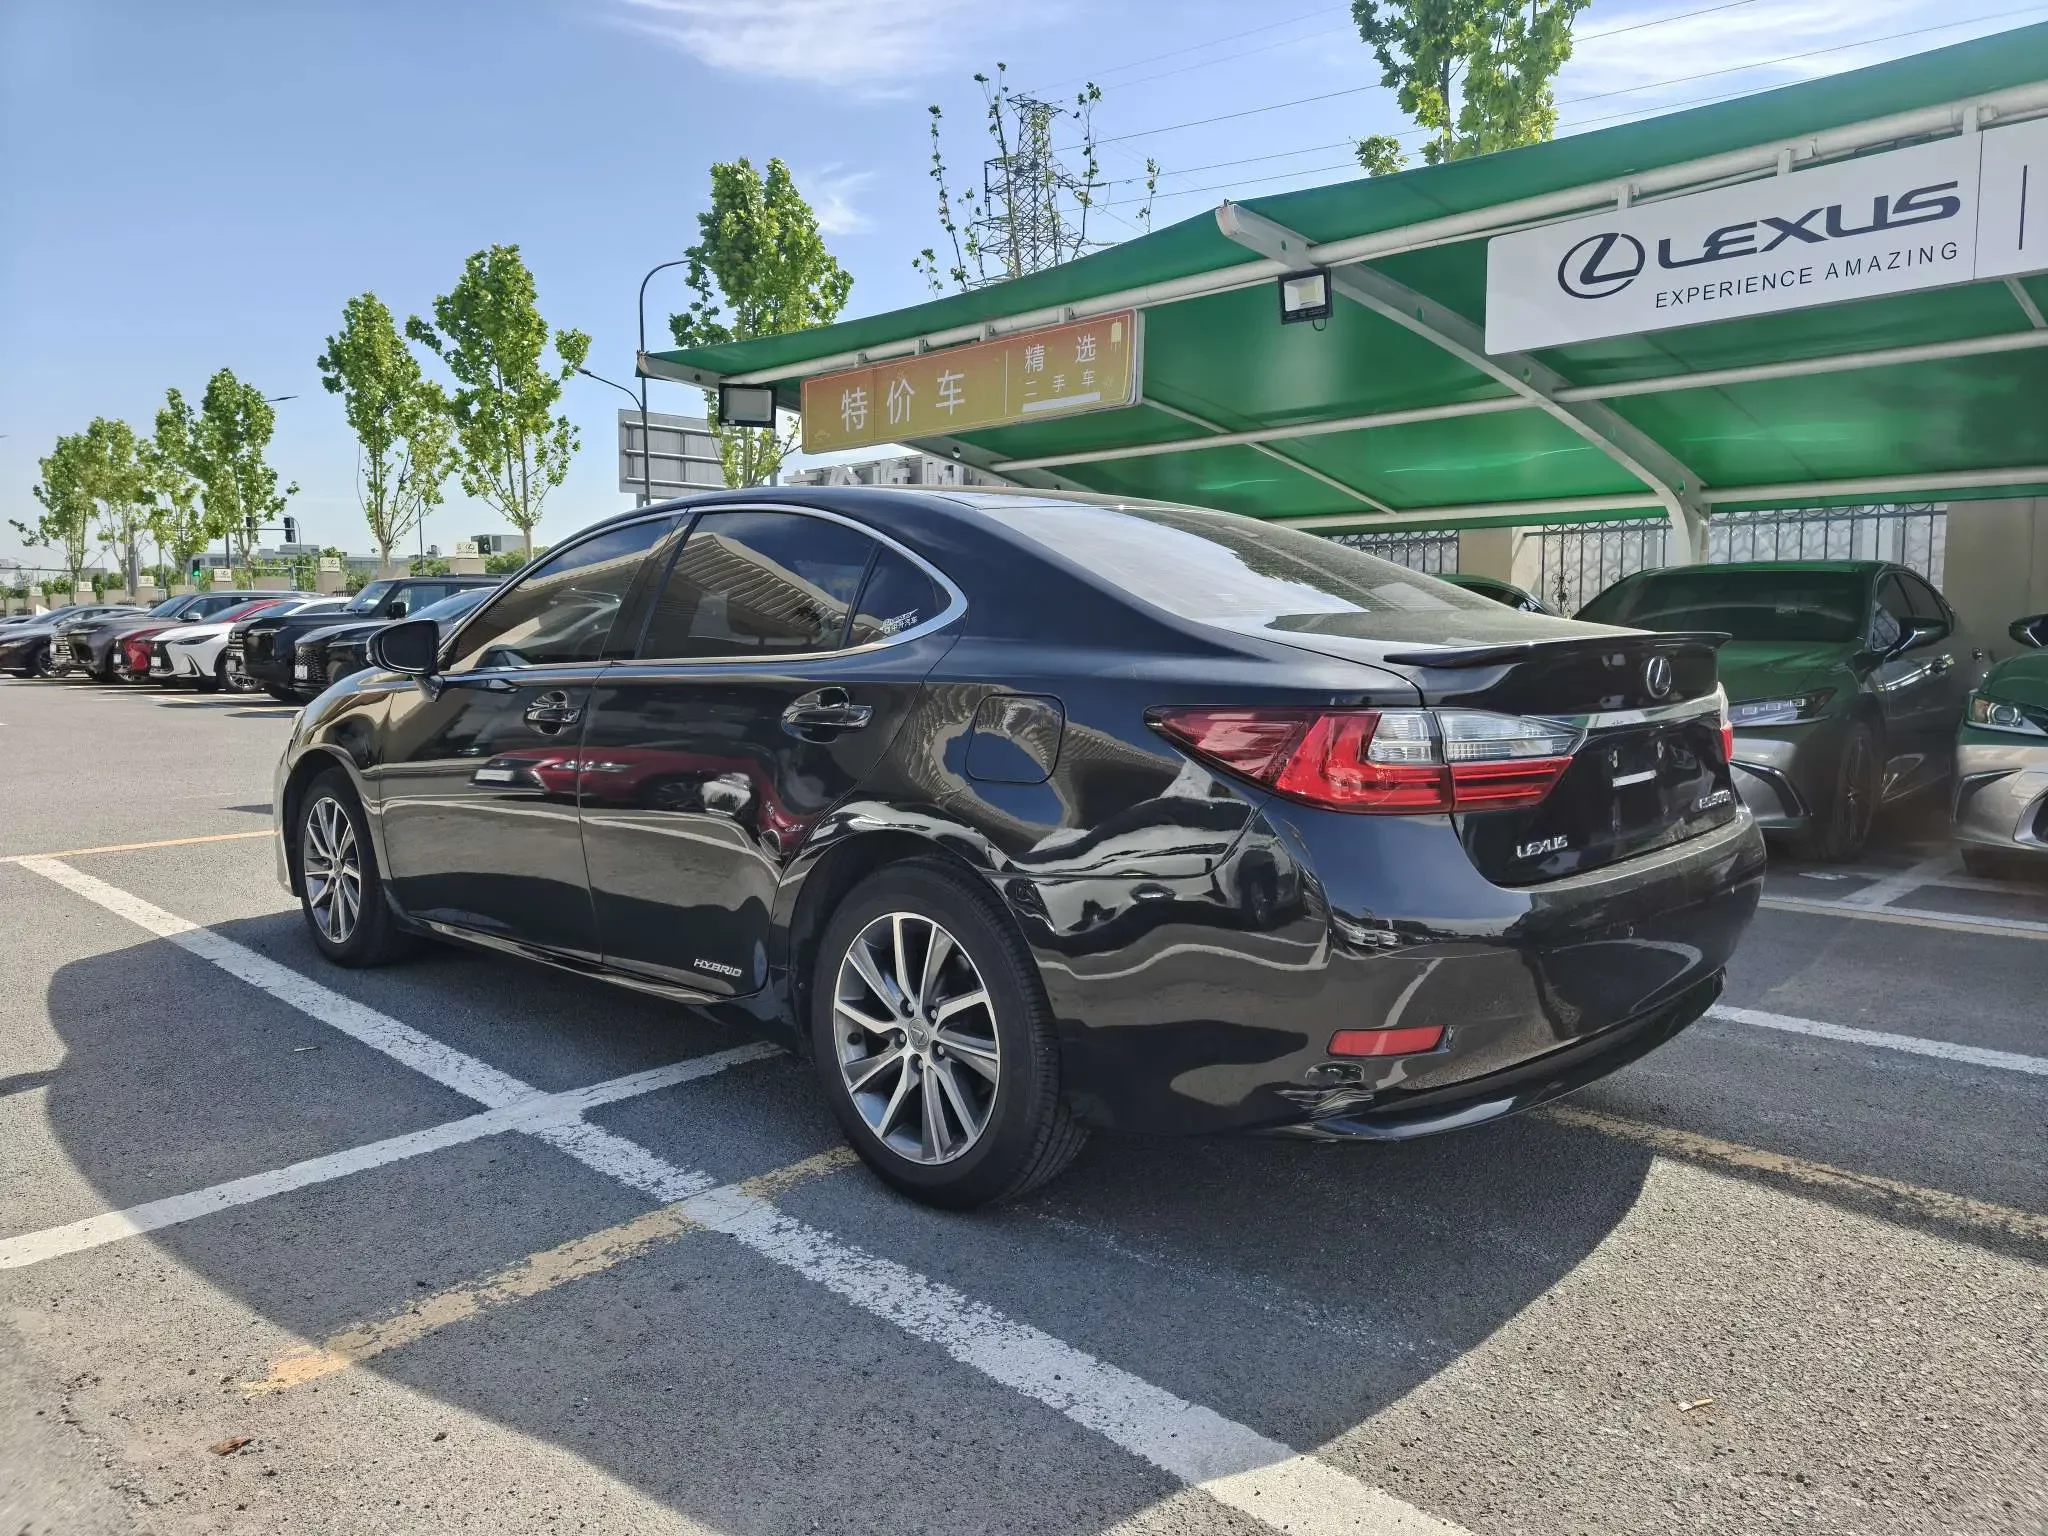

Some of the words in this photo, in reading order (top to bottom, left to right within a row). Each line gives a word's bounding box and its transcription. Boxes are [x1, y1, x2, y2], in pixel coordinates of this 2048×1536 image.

[1658, 181, 1960, 270] LEXUS
[1656, 267, 1813, 308] EXPERIENCE
[1825, 242, 1958, 280] AMAZING
[1024, 334, 1096, 373] 精选
[841, 370, 965, 432] 特价车
[1025, 369, 1095, 396] 二手车
[1517, 835, 1568, 858] LEXUS
[694, 959, 742, 977] HYBRID
